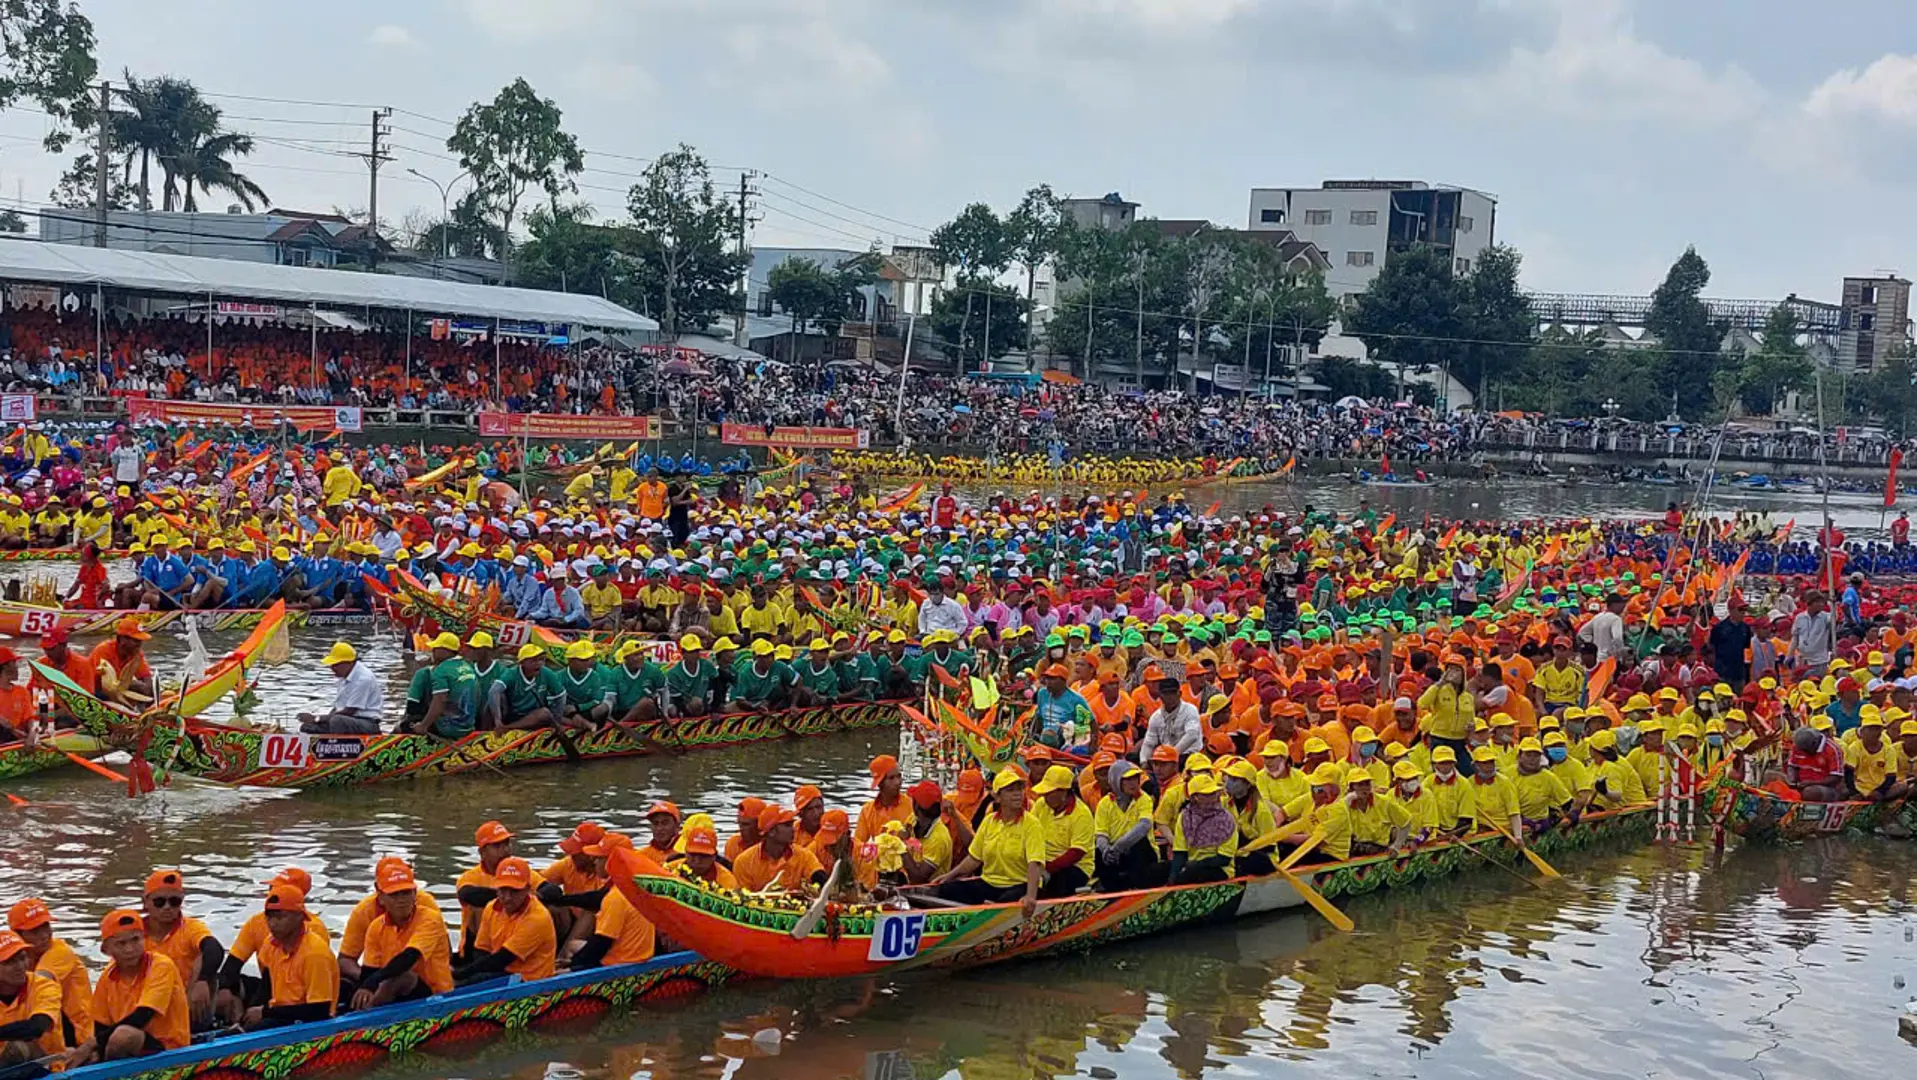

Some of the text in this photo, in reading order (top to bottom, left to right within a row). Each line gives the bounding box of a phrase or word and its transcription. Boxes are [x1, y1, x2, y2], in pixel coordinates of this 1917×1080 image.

[25, 612, 55, 632] 53
[499, 626, 525, 644] 51
[265, 736, 303, 766] 04
[1823, 805, 1845, 829] 15
[881, 915, 924, 958] 05
